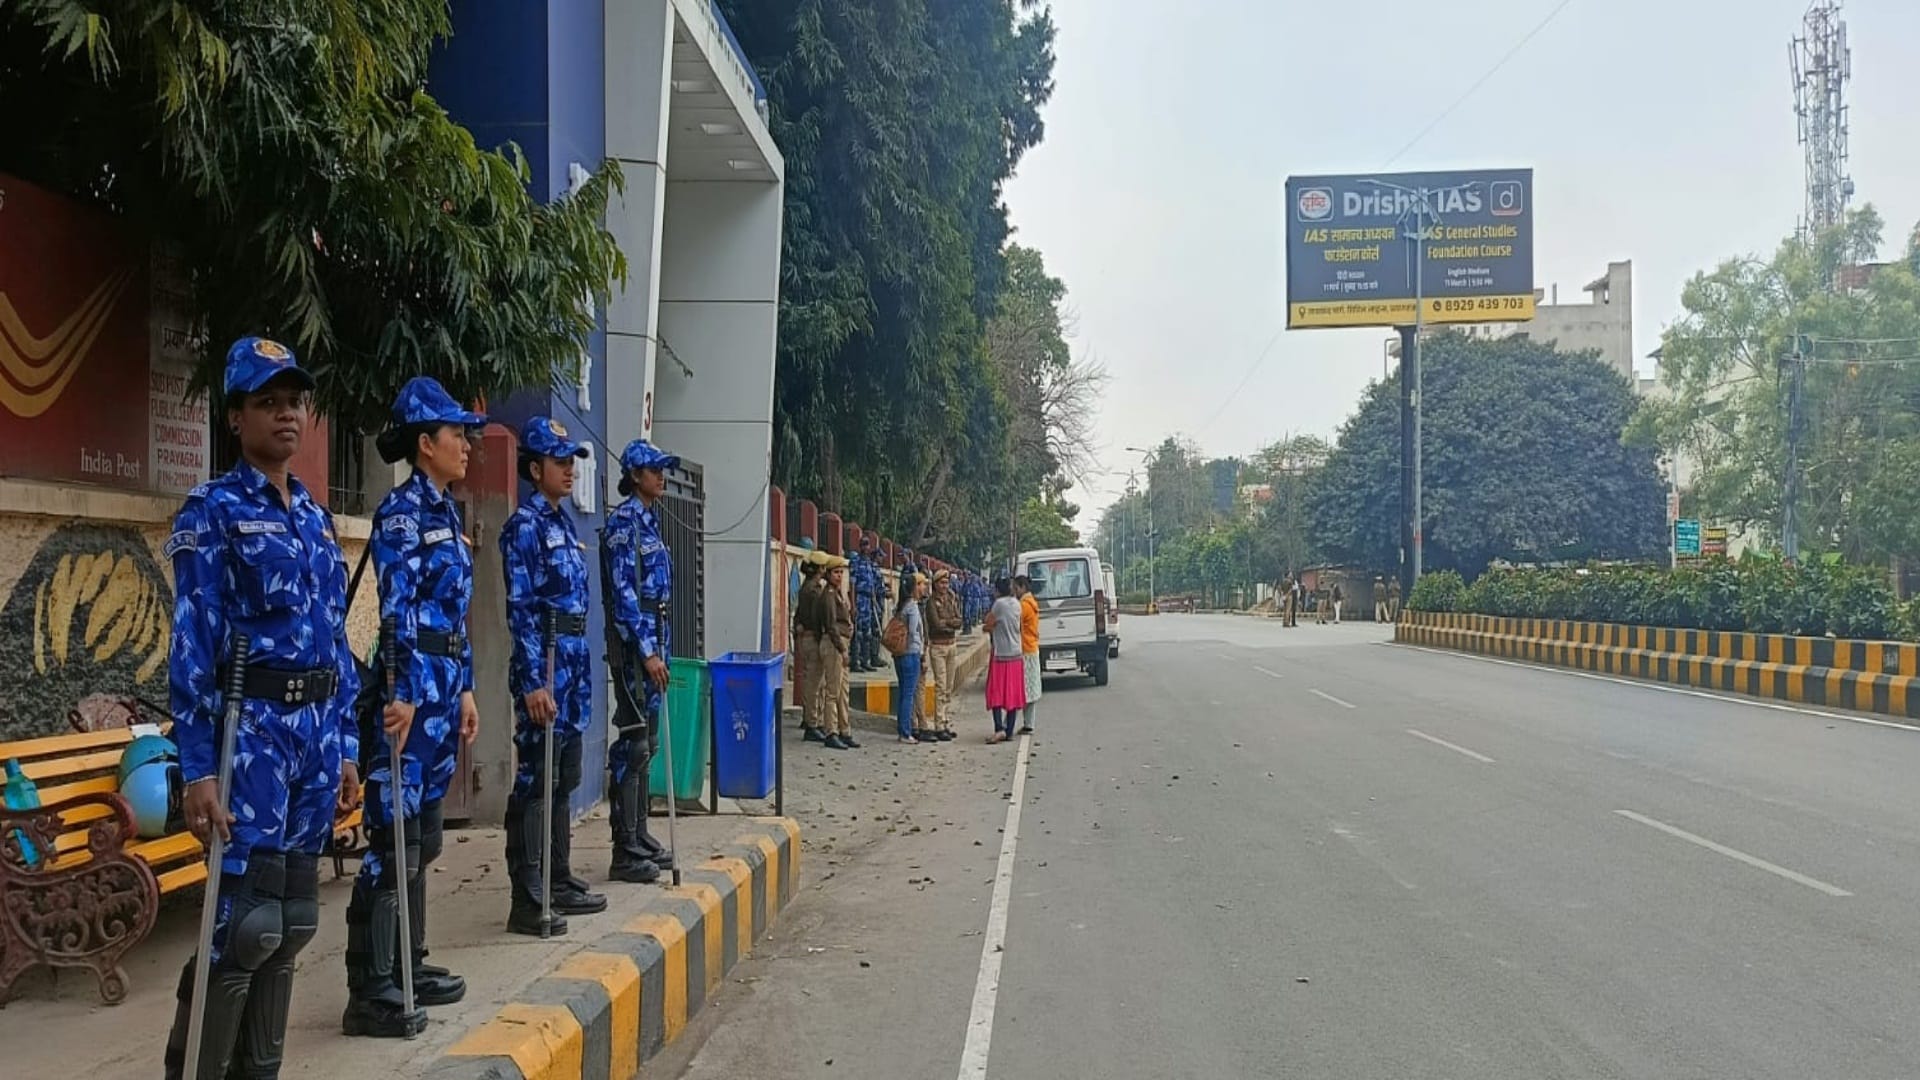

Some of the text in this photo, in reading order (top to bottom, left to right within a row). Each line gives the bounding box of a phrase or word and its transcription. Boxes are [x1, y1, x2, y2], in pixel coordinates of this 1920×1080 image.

[1343, 188, 1483, 217] Drishti IAS
[1304, 228, 1328, 243] IAS
[1447, 225, 1480, 239] General
[1482, 224, 1518, 239] Studies
[1427, 244, 1512, 259] Foundation Course
[1445, 297, 1524, 312] 8929 439 703
[151, 398, 177, 421] PUBLIC
[644, 391, 652, 431] 3
[155, 423, 203, 448] COMMISSION
[81, 447, 140, 480] India Post
[157, 447, 204, 469] PRAYAGRAJ
